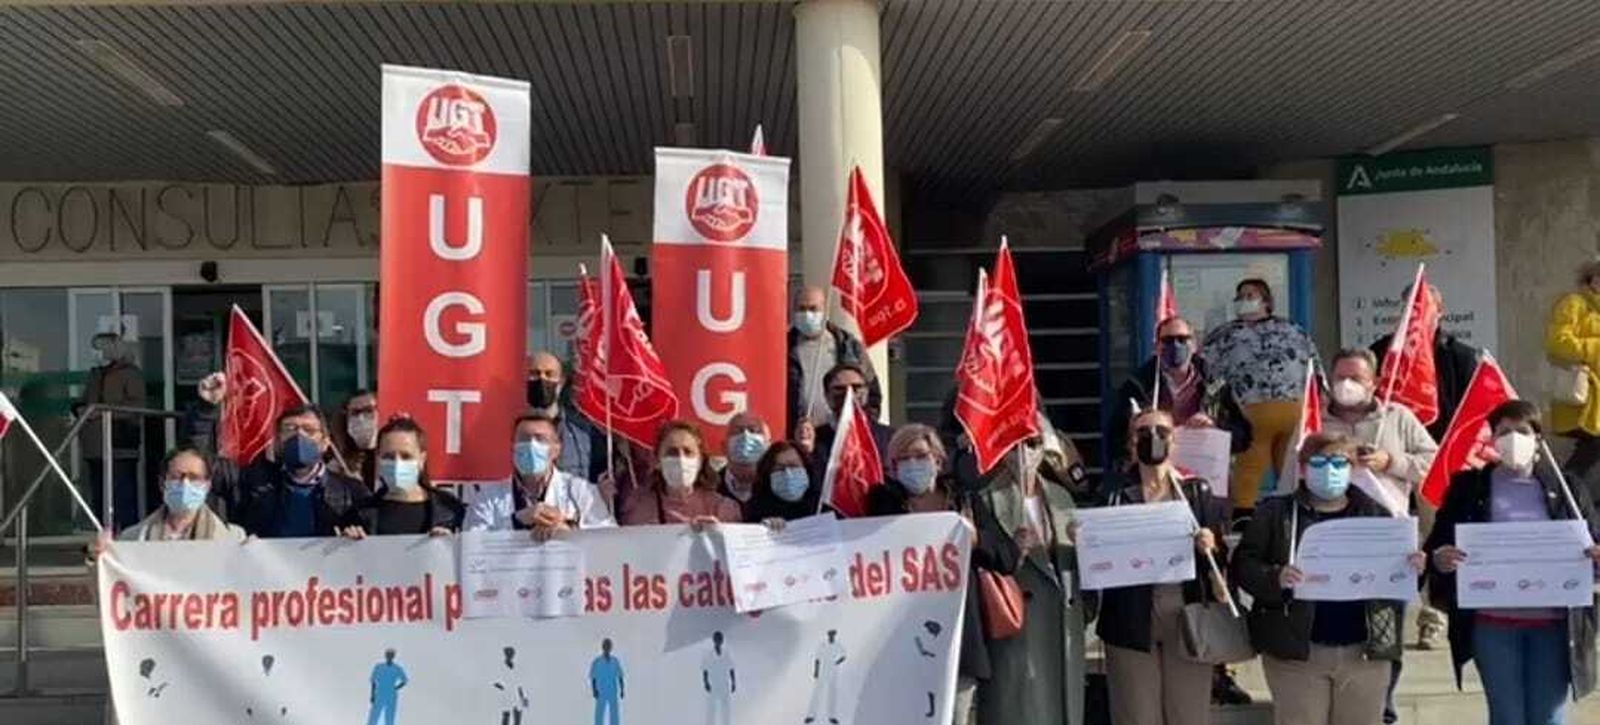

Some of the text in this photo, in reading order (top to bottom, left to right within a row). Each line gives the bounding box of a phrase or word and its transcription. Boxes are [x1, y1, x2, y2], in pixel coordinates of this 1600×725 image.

[426, 97, 485, 135] UGT
[695, 175, 750, 209] UGT
[1409, 166, 1423, 177] de
[11, 184, 381, 253] CONSULTA
[423, 194, 487, 454] UGT
[690, 269, 748, 426] UG
[109, 581, 239, 631] Carrera
[251, 573, 433, 641] profesional
[622, 563, 667, 611] las
[849, 551, 892, 599] del
[901, 543, 962, 593] SAS
